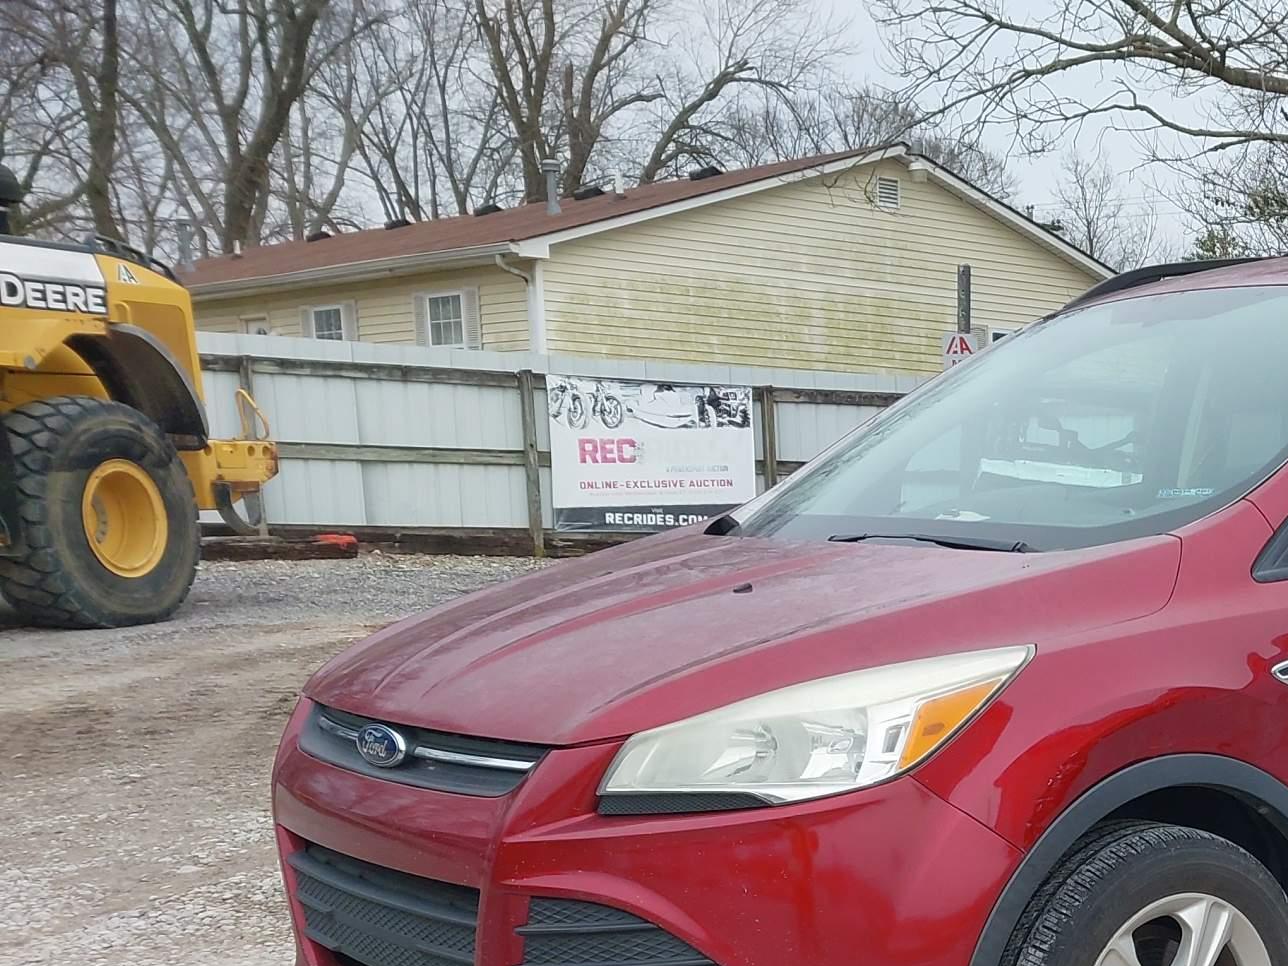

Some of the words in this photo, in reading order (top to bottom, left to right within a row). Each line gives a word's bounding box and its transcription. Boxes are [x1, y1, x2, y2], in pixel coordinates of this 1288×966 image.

[0, 273, 107, 313] DEERE
[580, 480, 685, 490] ONLINE-EXCLUSIVE
[689, 479, 733, 488] AUCTION
[362, 729, 388, 757] Ford
